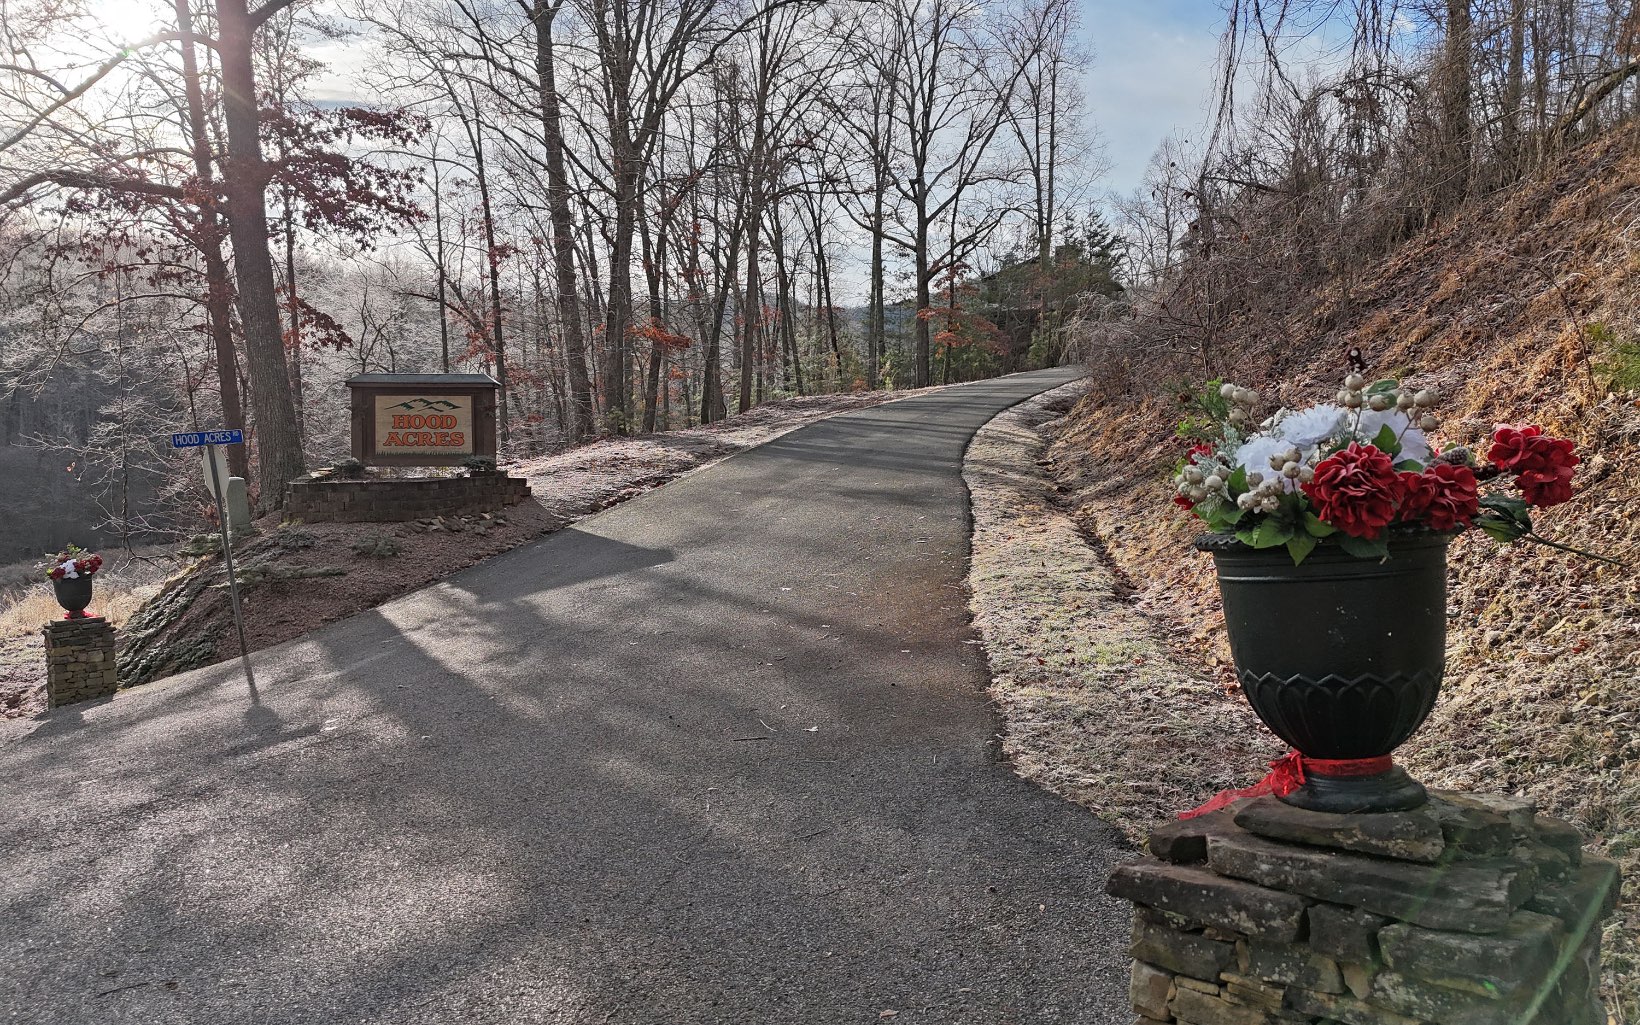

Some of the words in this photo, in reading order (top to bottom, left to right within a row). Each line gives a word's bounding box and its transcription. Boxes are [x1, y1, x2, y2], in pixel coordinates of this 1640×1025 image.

[392, 414, 458, 430] HOOD
[175, 434, 200, 445] HOOD
[204, 432, 232, 443] ACRES
[383, 432, 465, 447] ACRES
